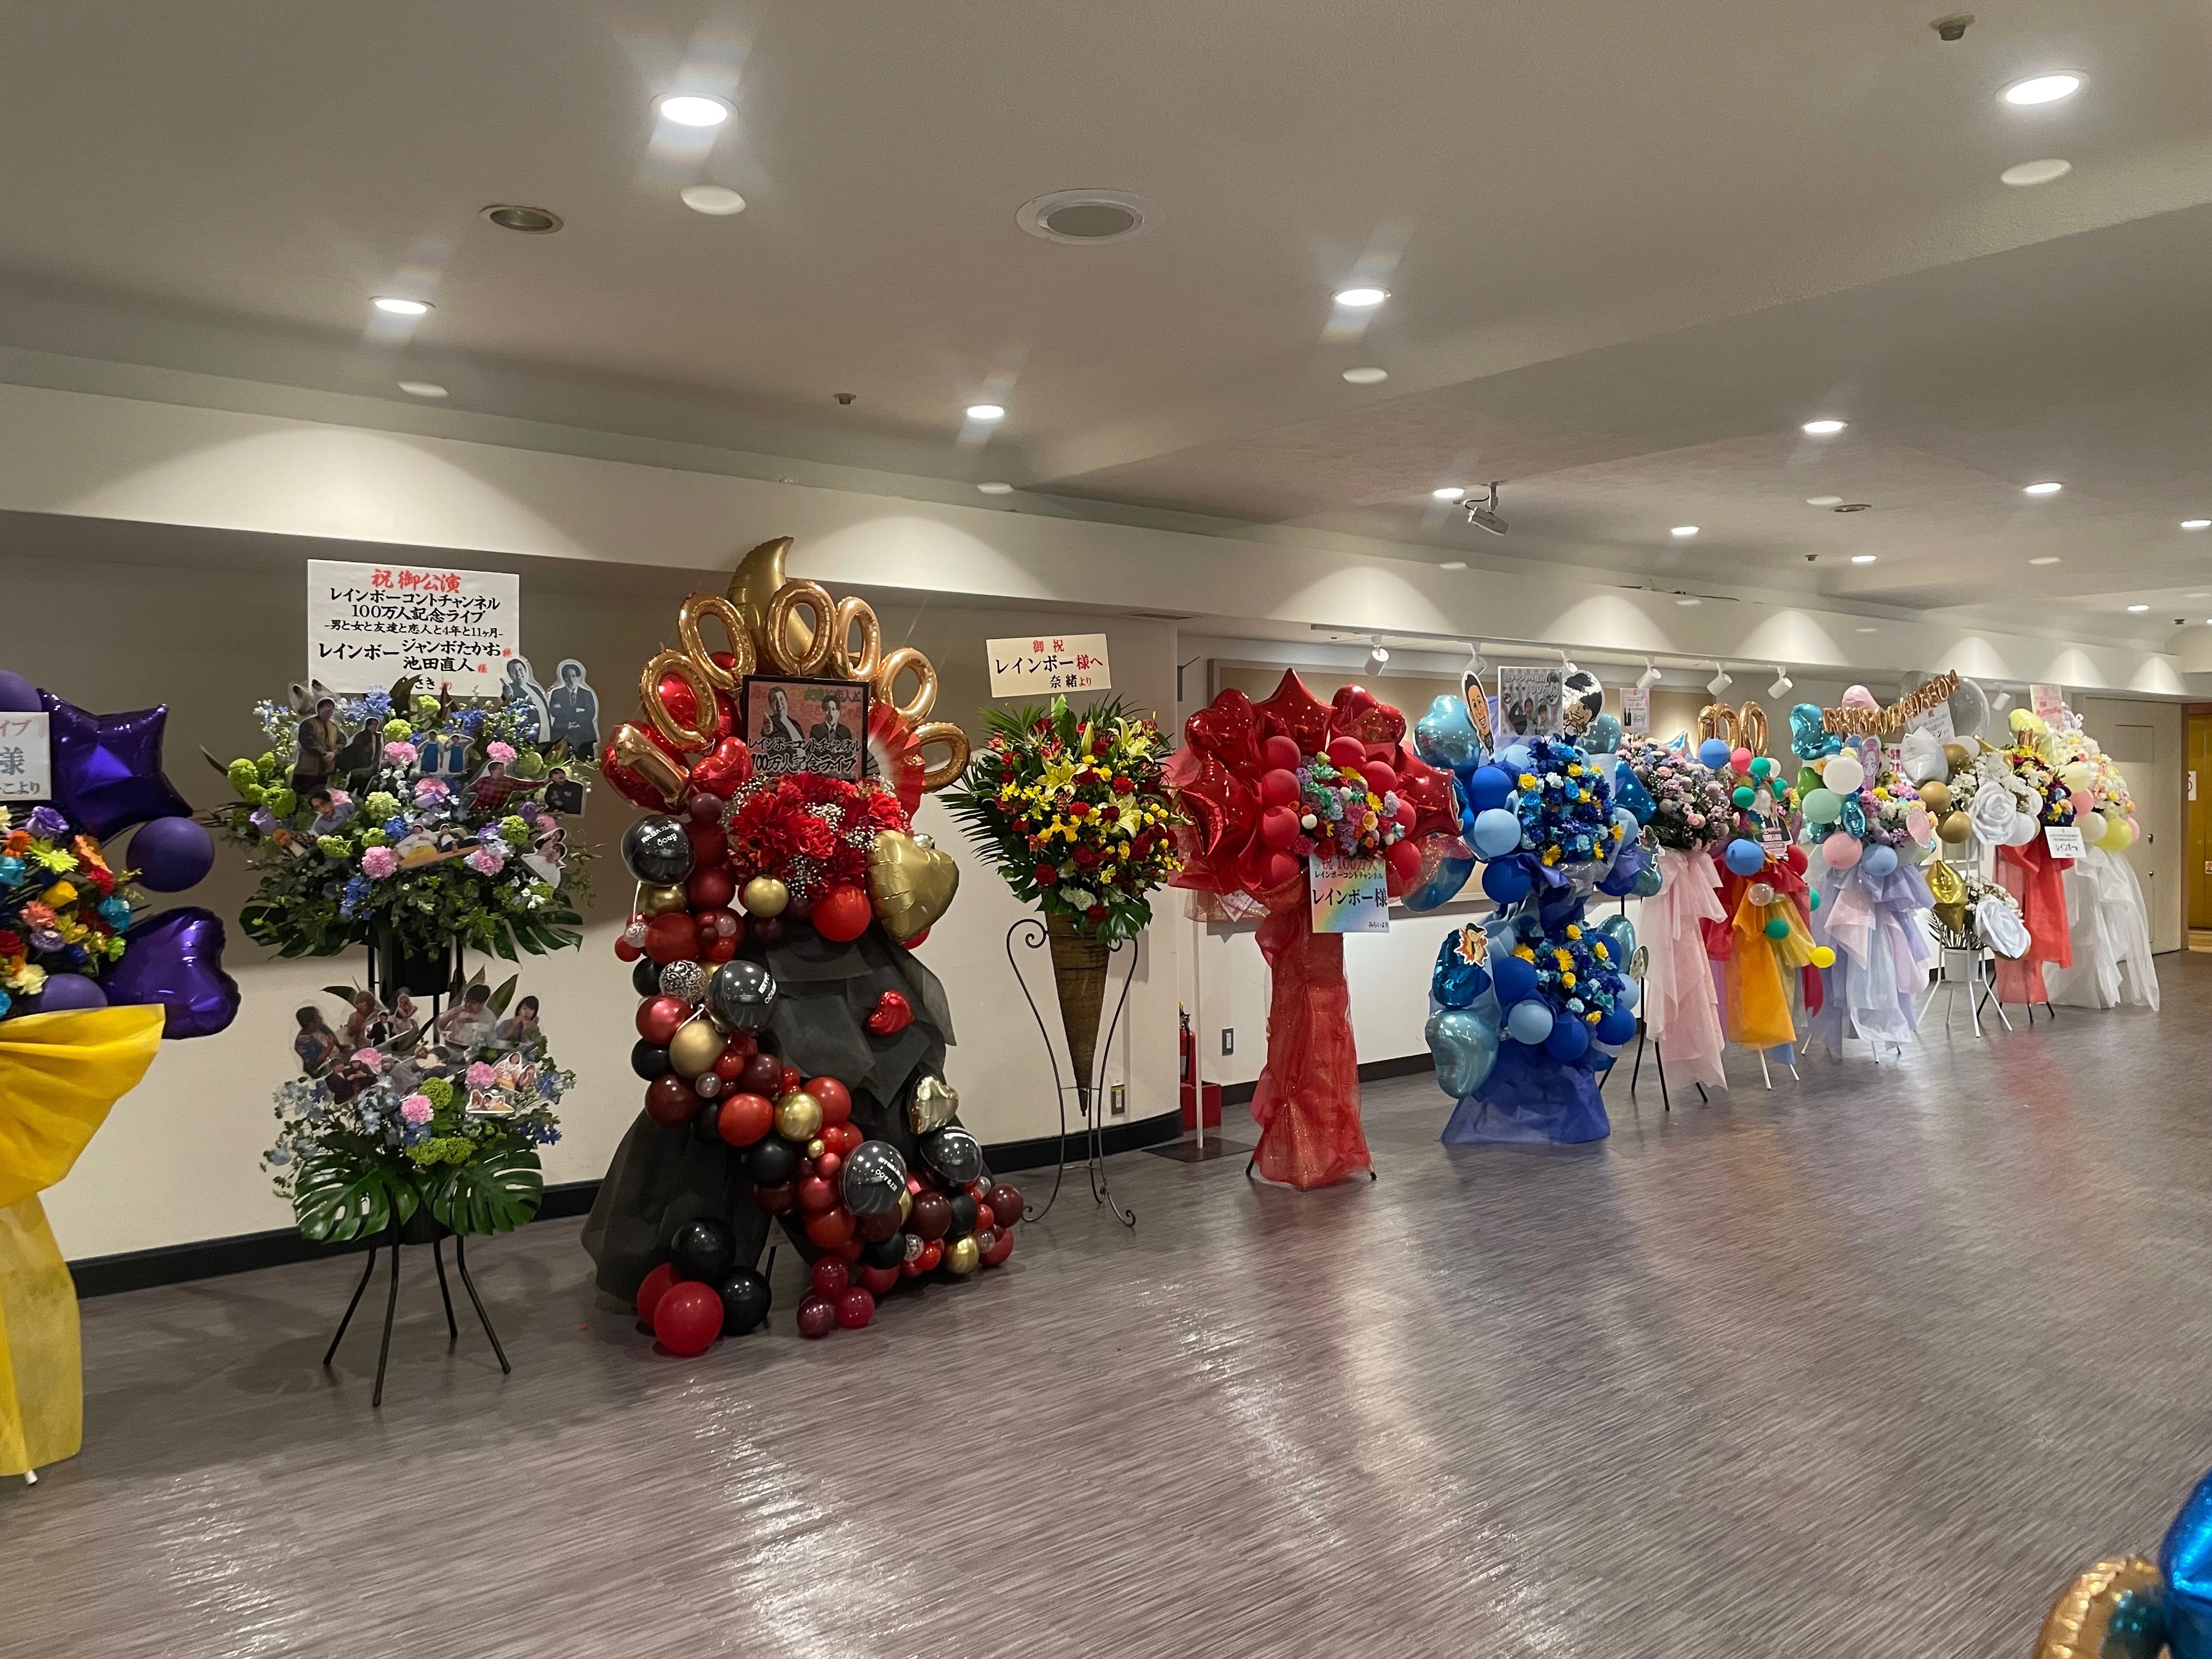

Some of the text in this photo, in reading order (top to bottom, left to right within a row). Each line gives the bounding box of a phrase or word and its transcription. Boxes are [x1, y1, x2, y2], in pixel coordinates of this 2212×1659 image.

[330, 587, 501, 611] レインボーコントチャンネル
[352, 604, 487, 624] 100万人記念ライブ
[318, 642, 401, 661] レインボー
[995, 654, 1103, 675] レインボー様へ
[747, 737, 862, 752] レインボーコントチャンネル
[752, 753, 858, 774] 100万人記念ライブ
[0, 780, 41, 795] こより
[1314, 870, 1384, 880] レインボーコントチャンネル
[1312, 887, 1388, 908] レインボー様
